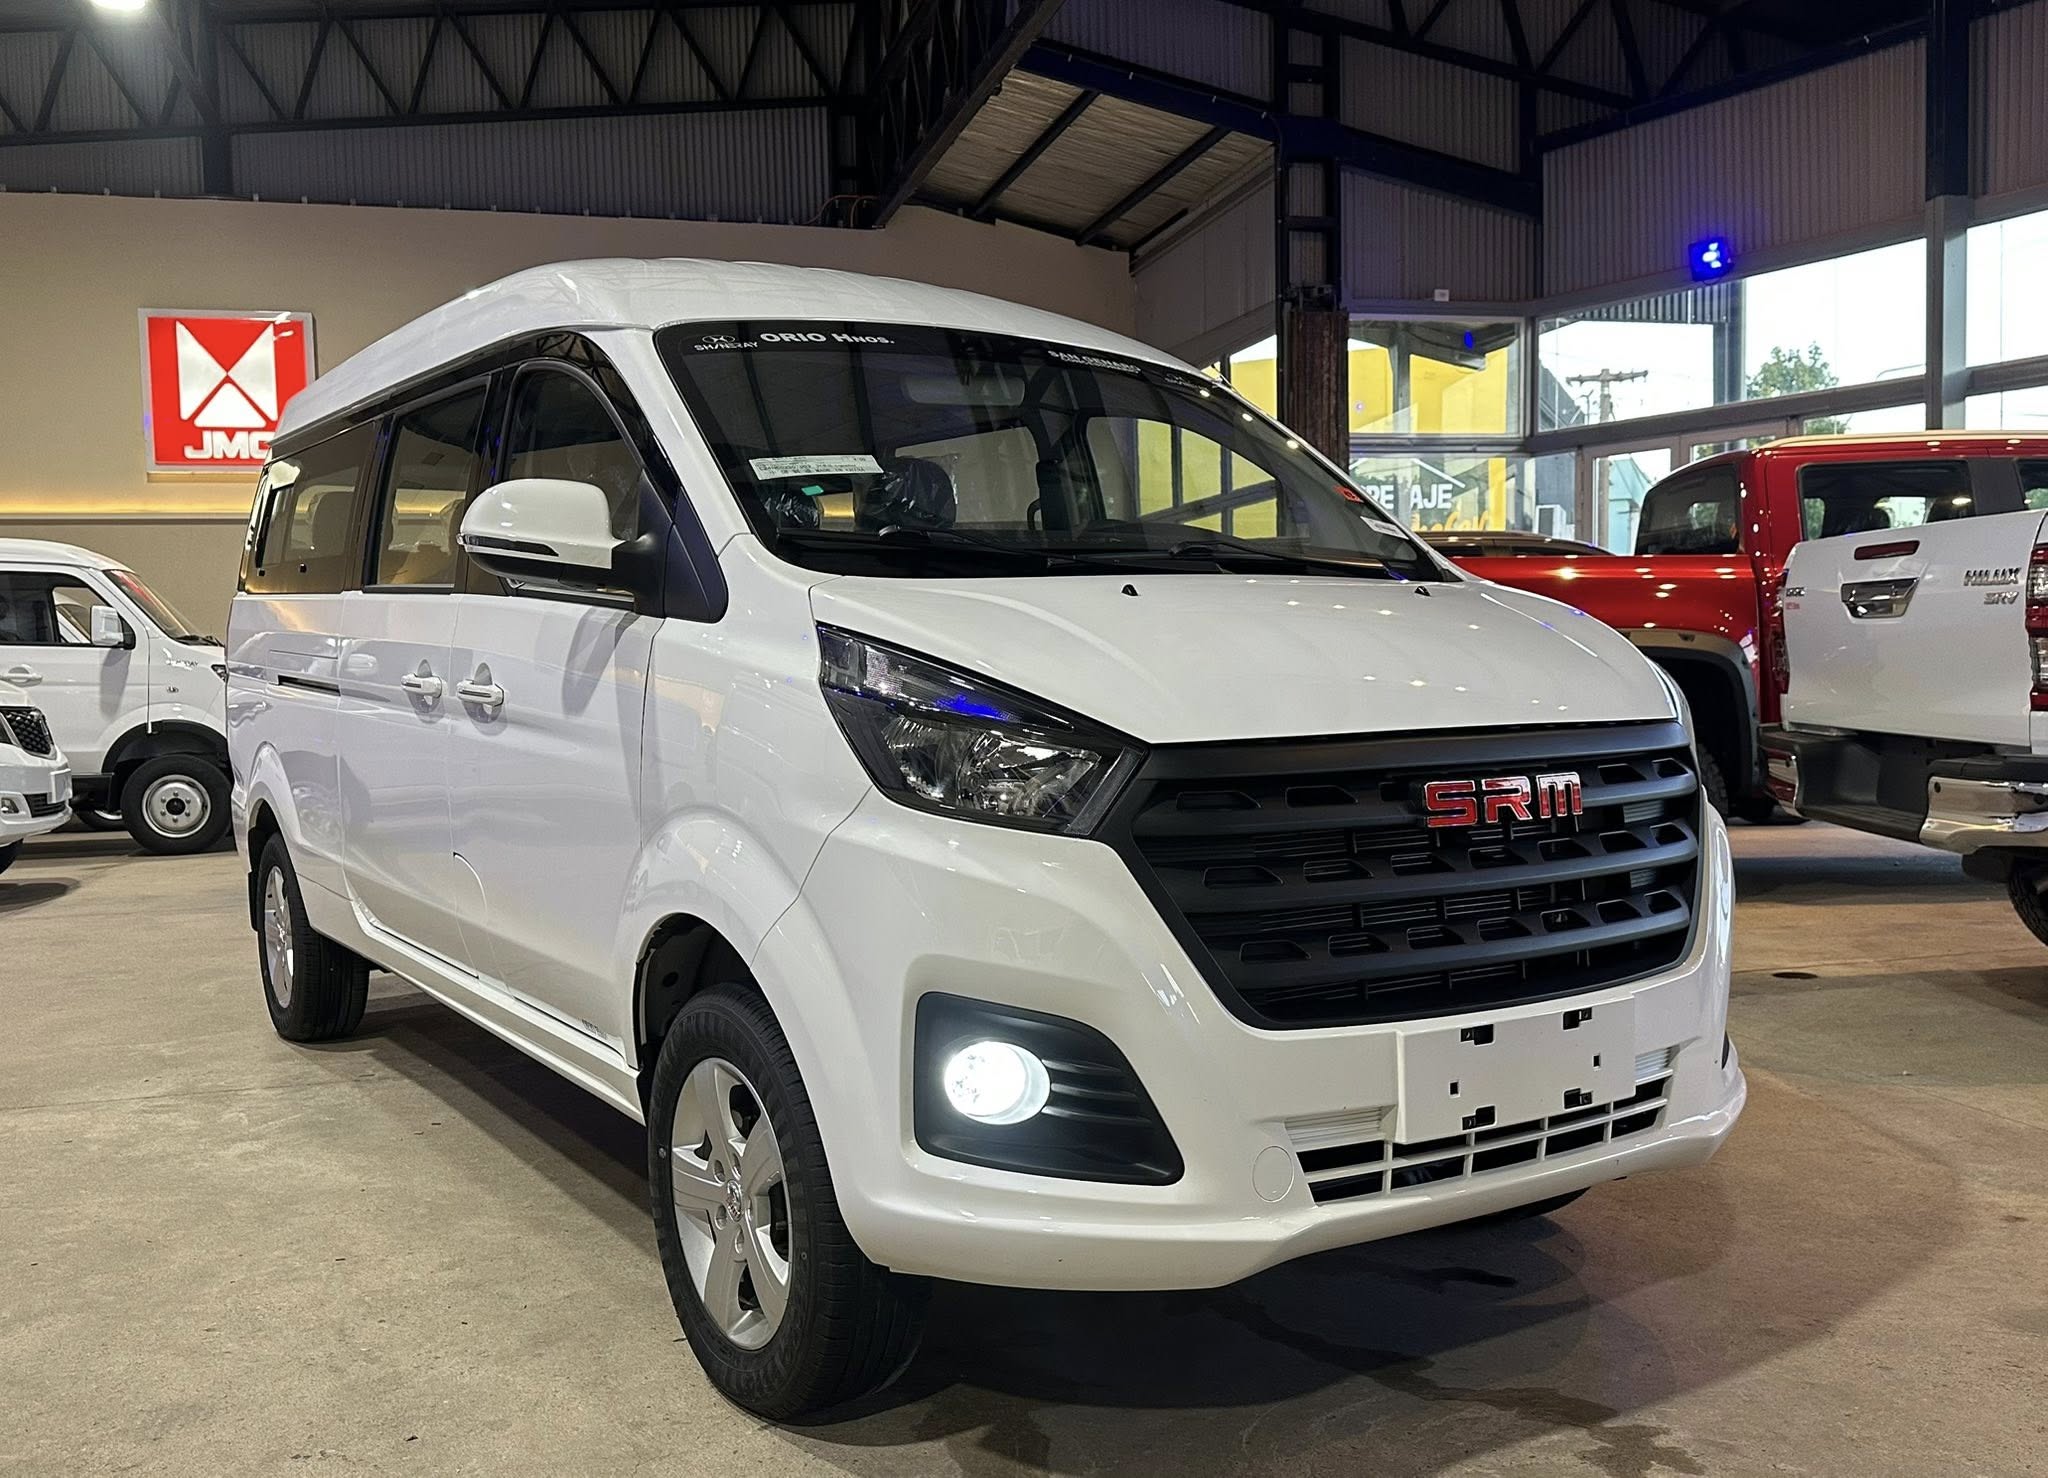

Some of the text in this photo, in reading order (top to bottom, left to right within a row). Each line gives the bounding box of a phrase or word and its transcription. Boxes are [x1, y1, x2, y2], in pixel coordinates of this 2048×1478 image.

[760, 332, 827, 343] ORIO
[183, 430, 276, 460] JMC
[1963, 567, 2022, 586] HILUX
[1424, 771, 1583, 828] SRM
